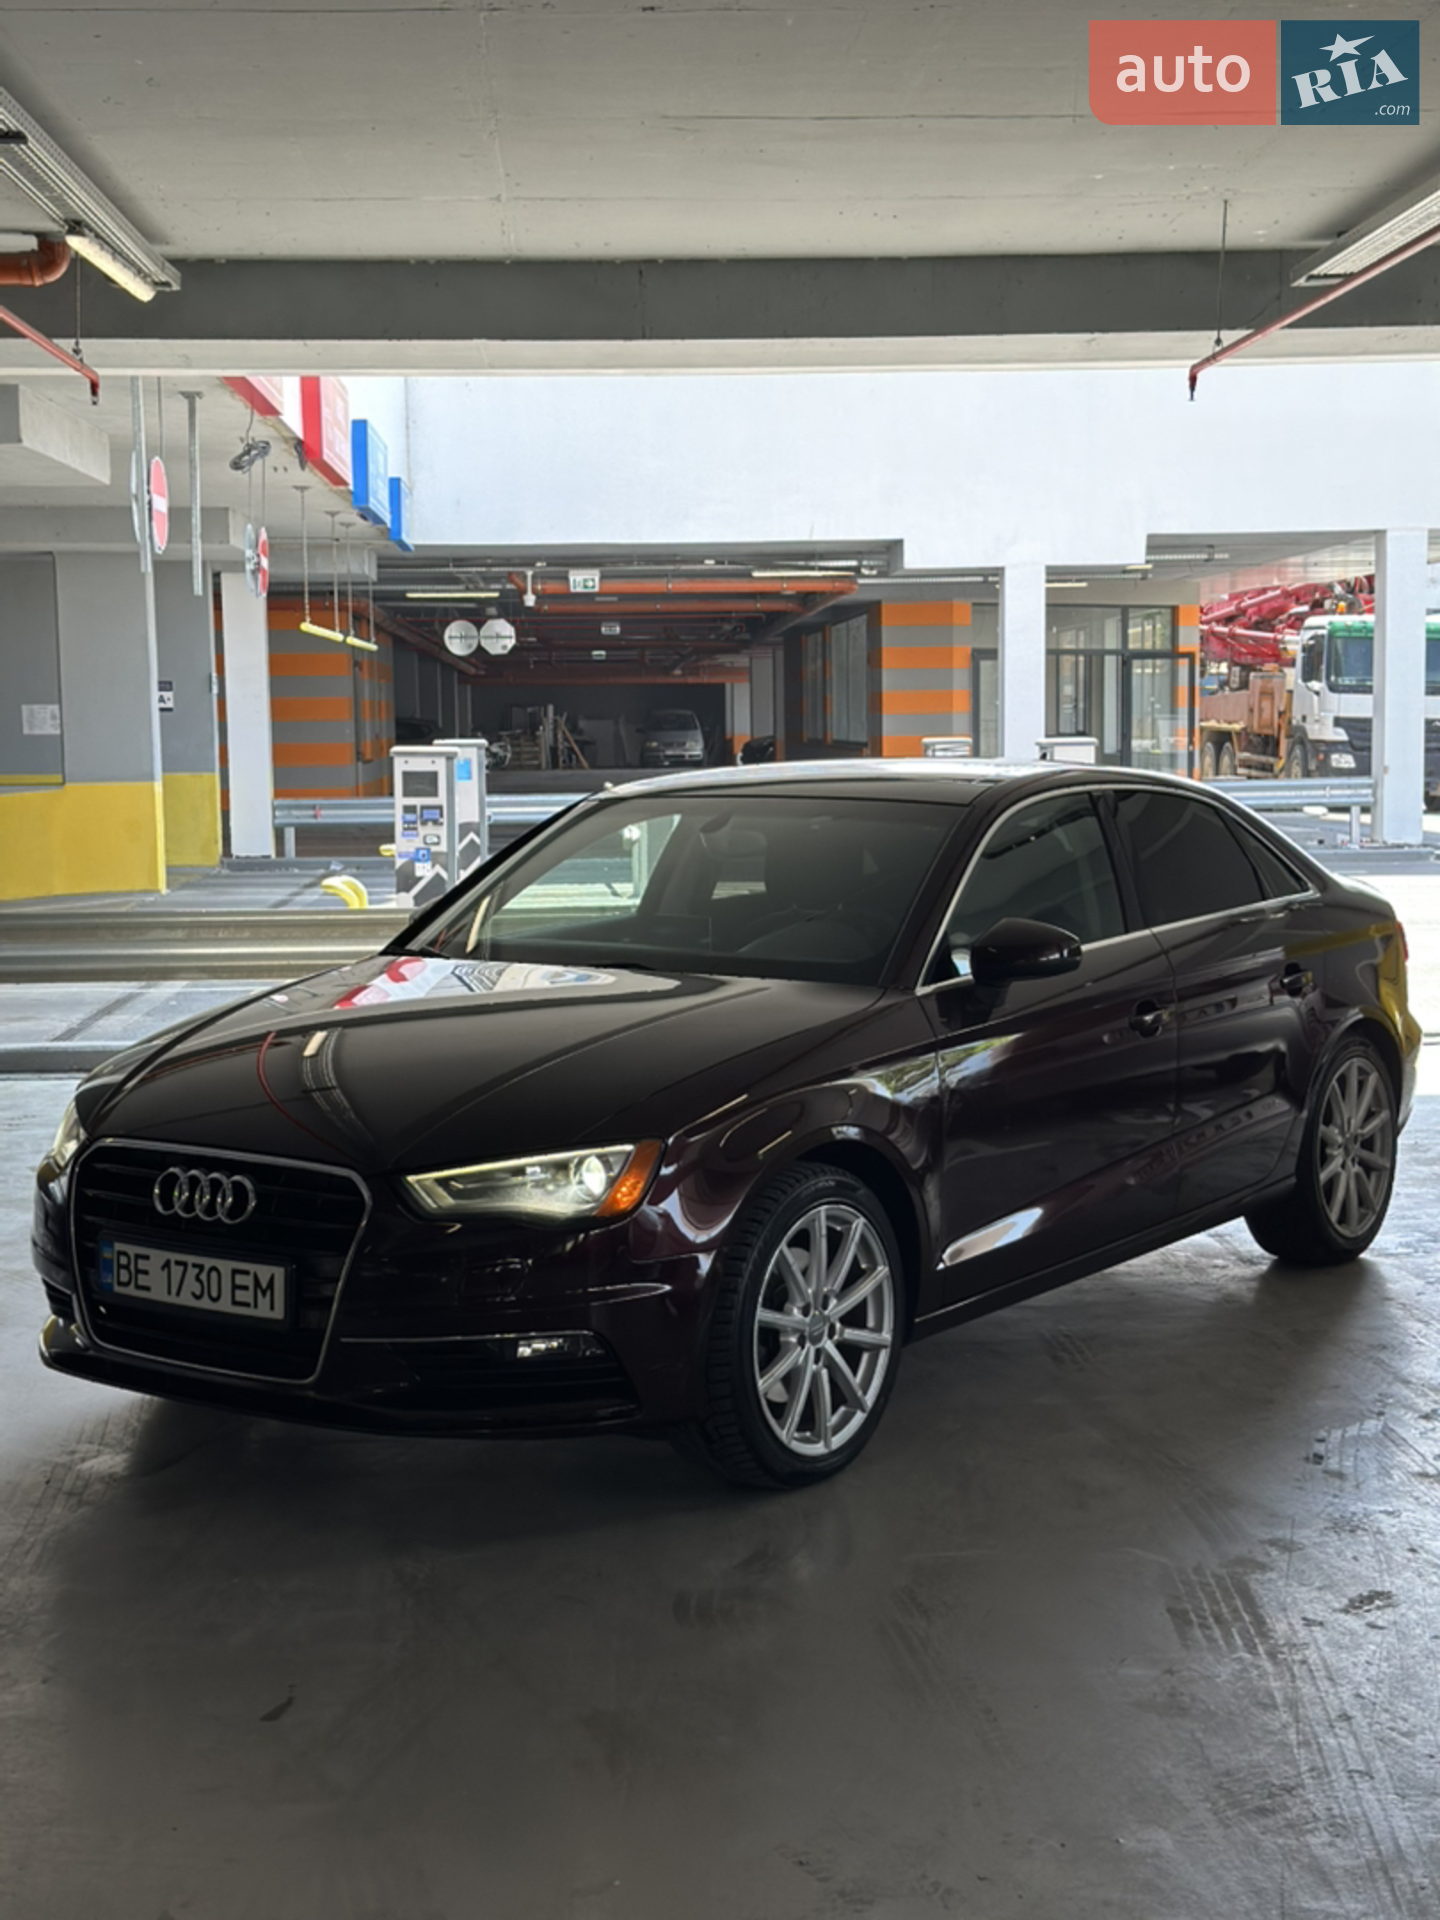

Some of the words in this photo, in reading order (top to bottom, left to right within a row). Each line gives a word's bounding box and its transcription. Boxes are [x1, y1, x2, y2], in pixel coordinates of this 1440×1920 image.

[116, 1250, 151, 1292] BE
[160, 1258, 222, 1303] 1730
[230, 1267, 275, 1312] EM
